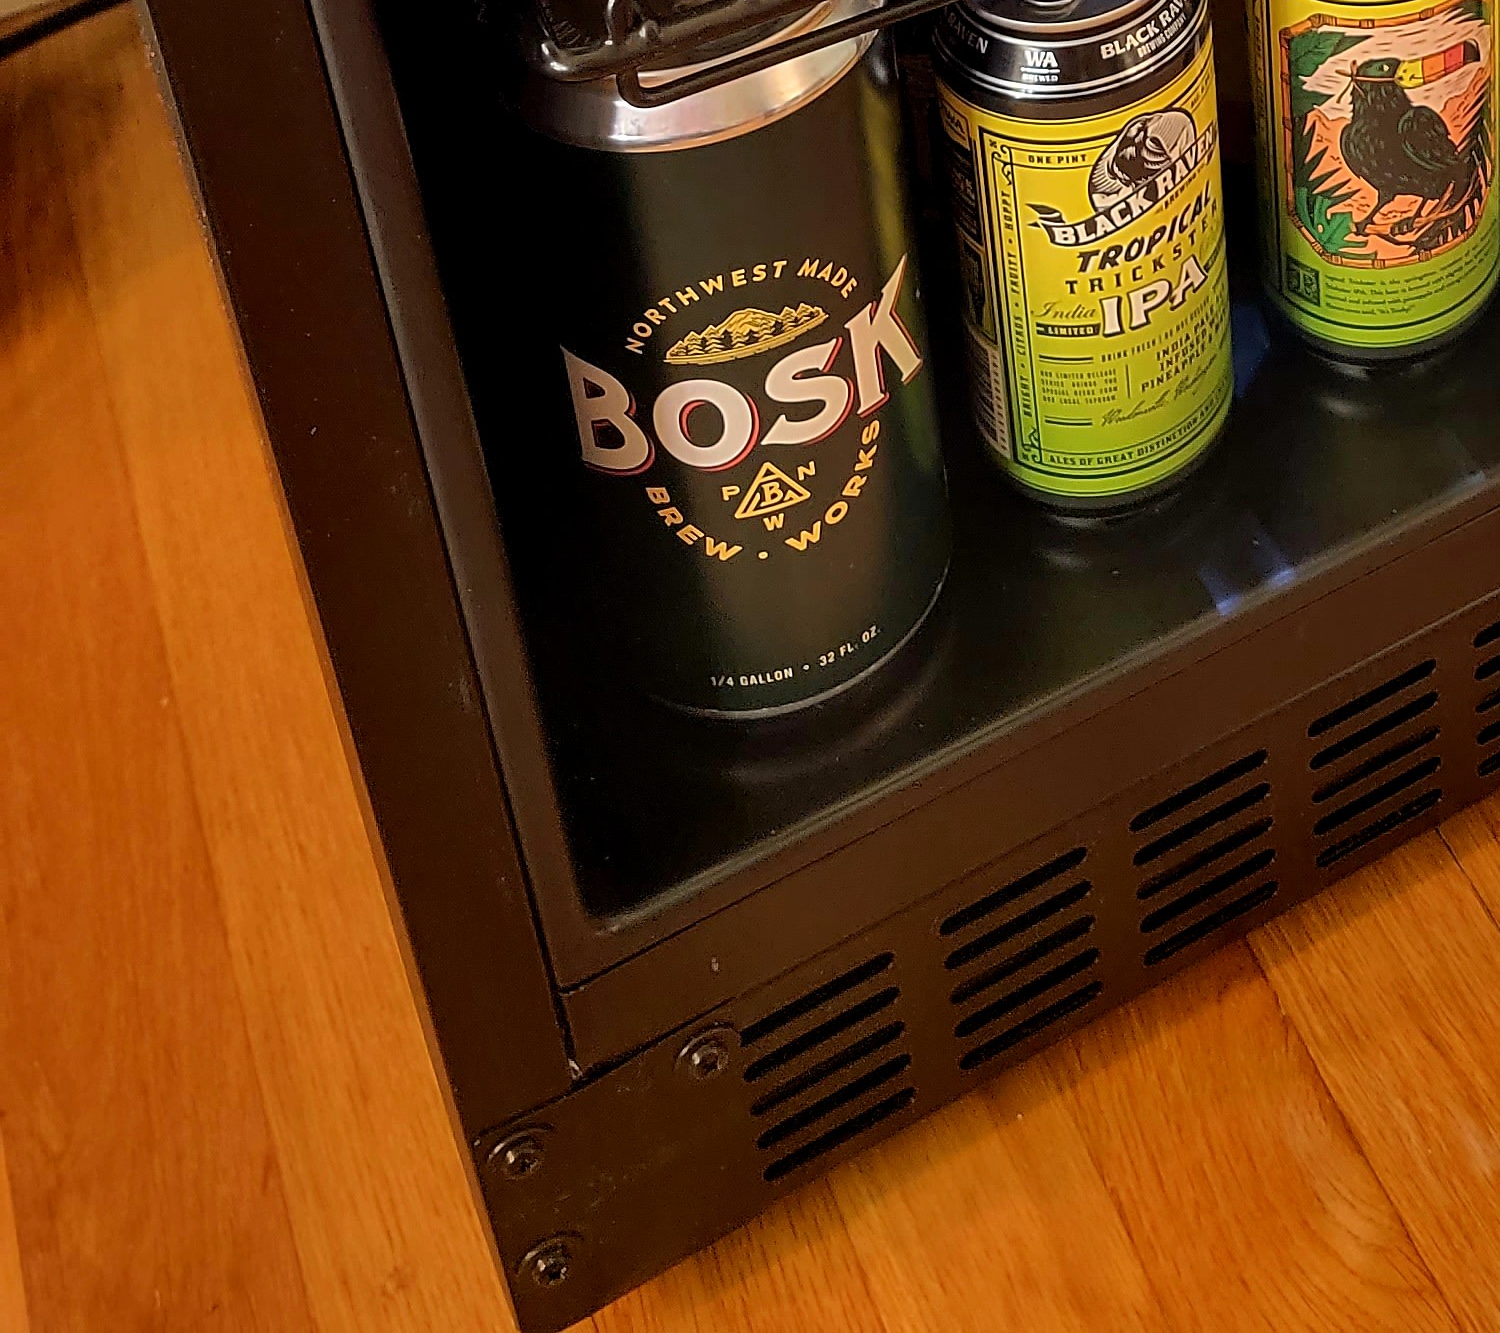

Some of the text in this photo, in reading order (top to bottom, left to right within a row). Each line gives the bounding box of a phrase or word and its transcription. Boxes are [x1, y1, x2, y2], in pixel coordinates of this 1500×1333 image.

[1024, 50, 1058, 68] WA
[1100, 20, 1158, 60] BLACK
[1137, 30, 1165, 58] BREWING
[1028, 153, 1087, 163] ONE PINT
[1052, 130, 1215, 245] BLACK RAVEN
[1076, 180, 1211, 272] TROPICAL
[625, 257, 860, 356] NORTHWEST MADE
[1031, 301, 1097, 319] India
[1100, 255, 1208, 337] IPA
[1048, 326, 1094, 335] LIMITED
[1157, 336, 1190, 360] INDIA
[559, 253, 924, 475] BOSK
[1049, 455, 1076, 466] ALES
[1097, 451, 1134, 464] GREAT
[1137, 416, 1198, 456] DISTINCTION
[646, 418, 880, 561] BREW WORKS
[710, 625, 881, 687] 1/4 GALLON 32 FL. OZ.
